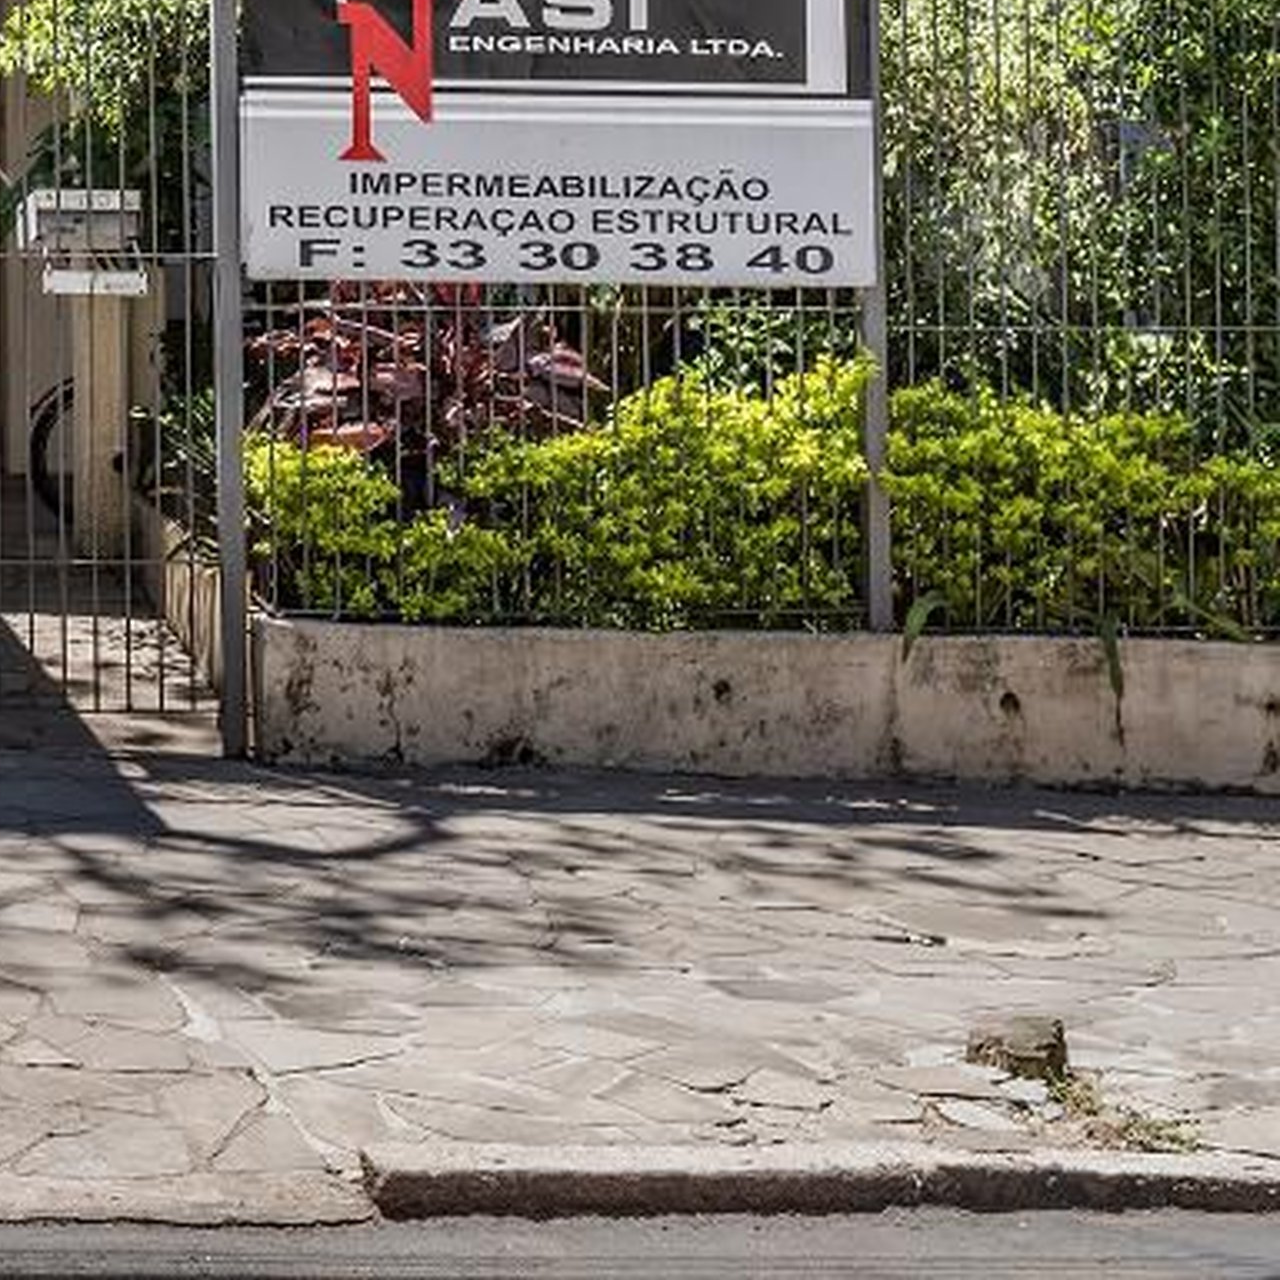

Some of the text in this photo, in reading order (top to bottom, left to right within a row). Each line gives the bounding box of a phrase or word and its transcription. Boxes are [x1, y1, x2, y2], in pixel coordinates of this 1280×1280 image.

[448, 35, 785, 59] ENGENHARIA LTDA.
[349, 169, 770, 206] IMPERMEABILIZAÇÃO
[592, 209, 853, 236] ESTRUTURAL
[299, 238, 834, 274] F: 33 30 38 40
